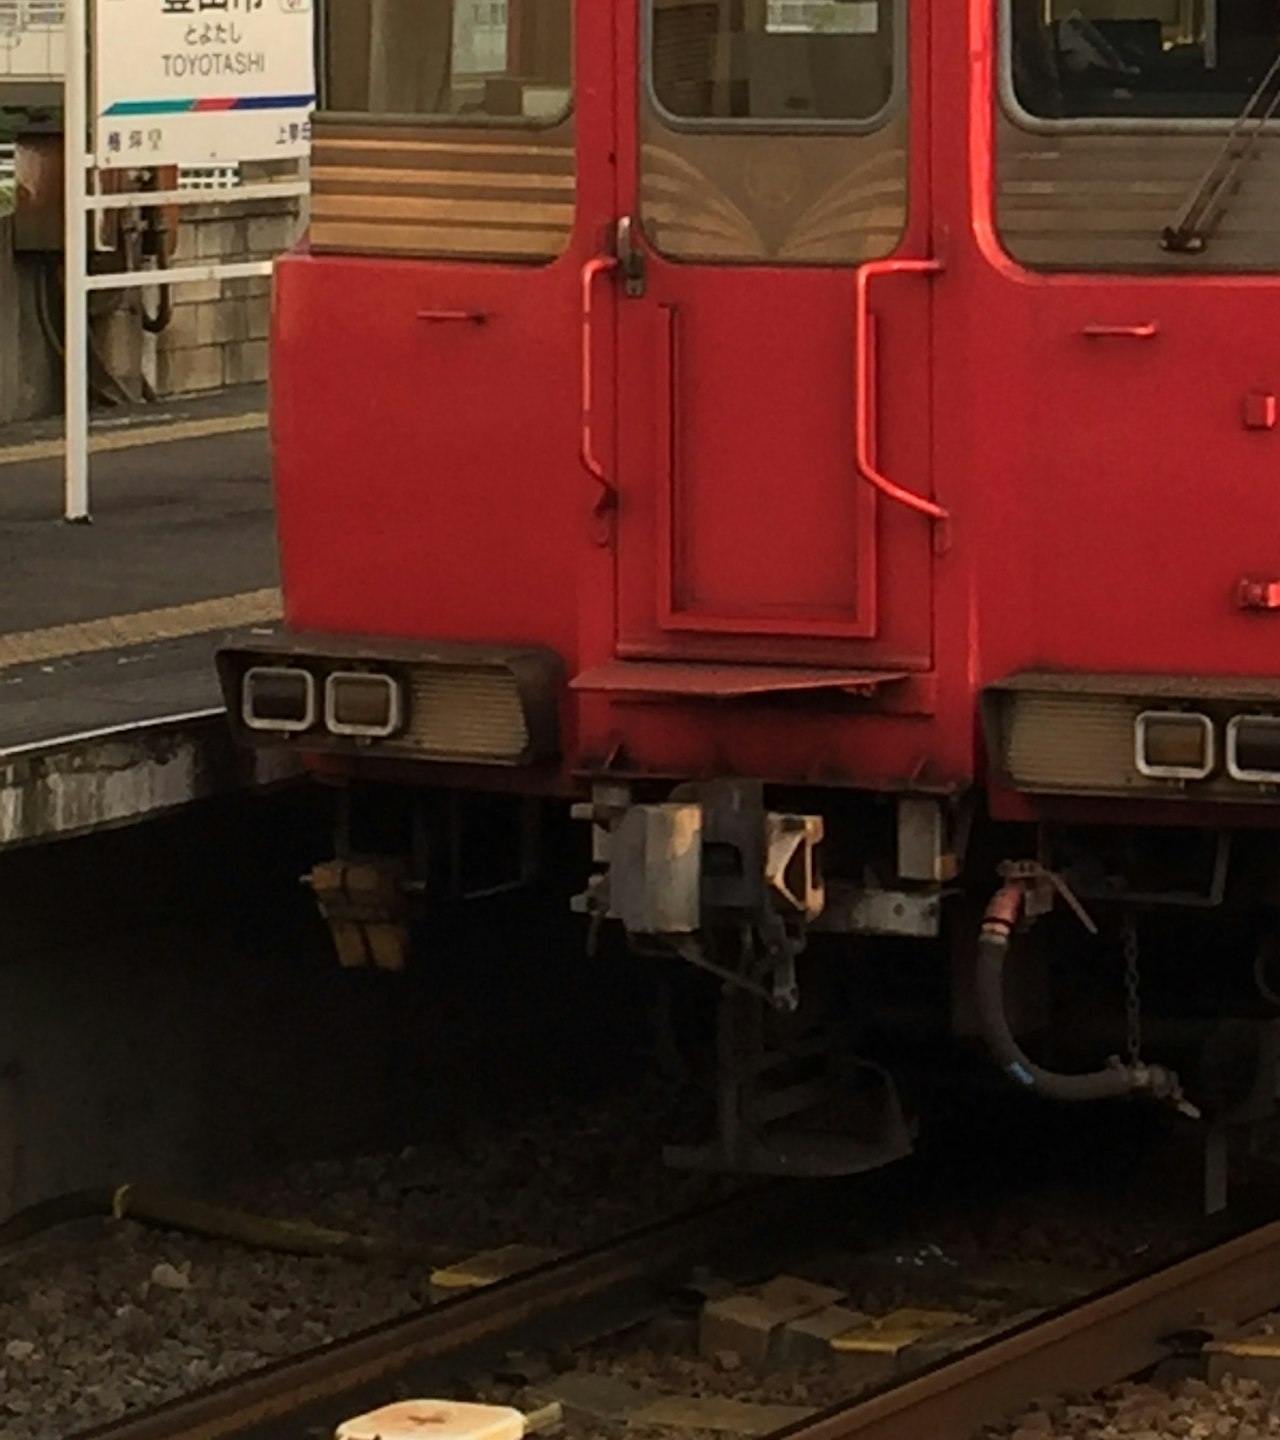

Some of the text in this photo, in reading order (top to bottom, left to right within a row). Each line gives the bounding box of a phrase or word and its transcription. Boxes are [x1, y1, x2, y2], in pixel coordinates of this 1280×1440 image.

[184, 21, 243, 46] とよたし
[161, 53, 266, 78] TOYOTASHI
